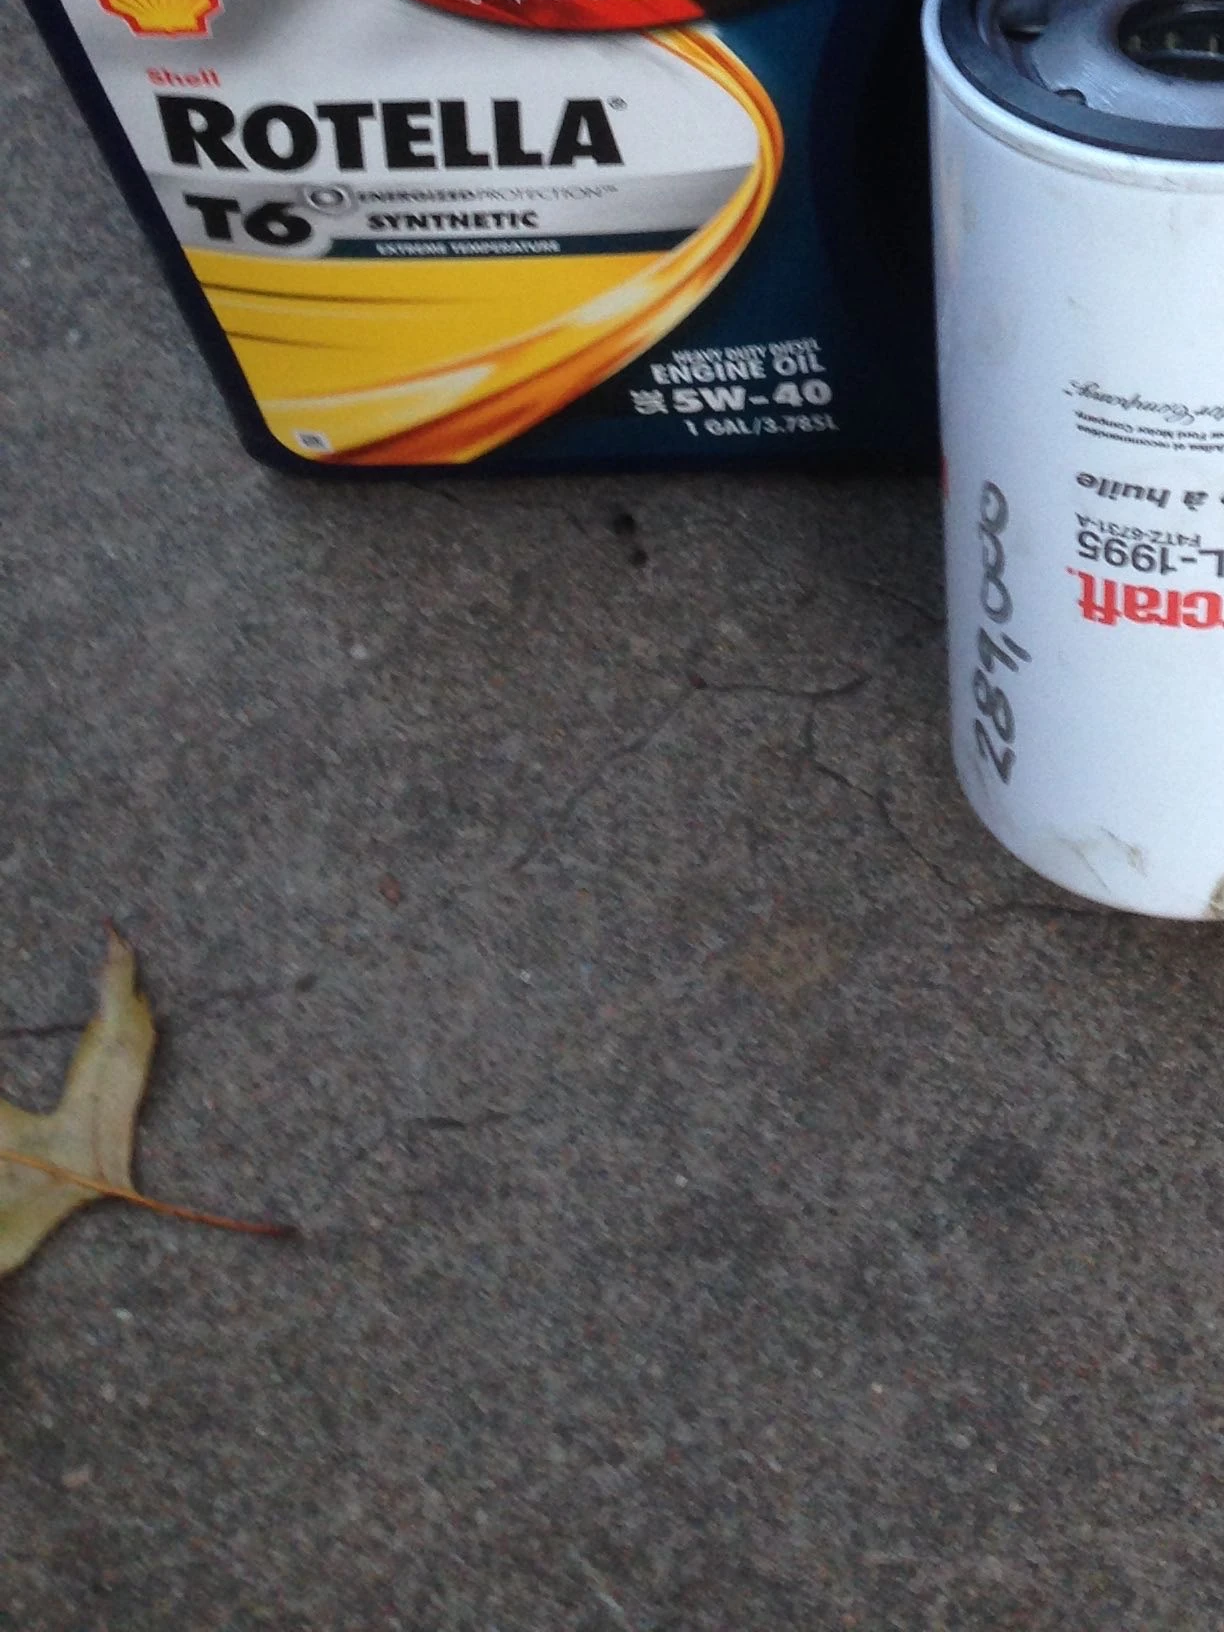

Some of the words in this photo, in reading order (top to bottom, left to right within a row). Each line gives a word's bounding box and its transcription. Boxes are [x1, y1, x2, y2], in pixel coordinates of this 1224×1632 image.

[147, 68, 221, 88] Shell
[181, 192, 313, 247] T6
[367, 210, 540, 231] SYNTHETIC
[651, 360, 767, 385] ENGINE
[773, 353, 827, 377] OIL
[672, 379, 832, 413] 5W-40
[684, 419, 699, 436] 1
[1074, 472, 1171, 510] huile
[1181, 490, 1209, 513] à
